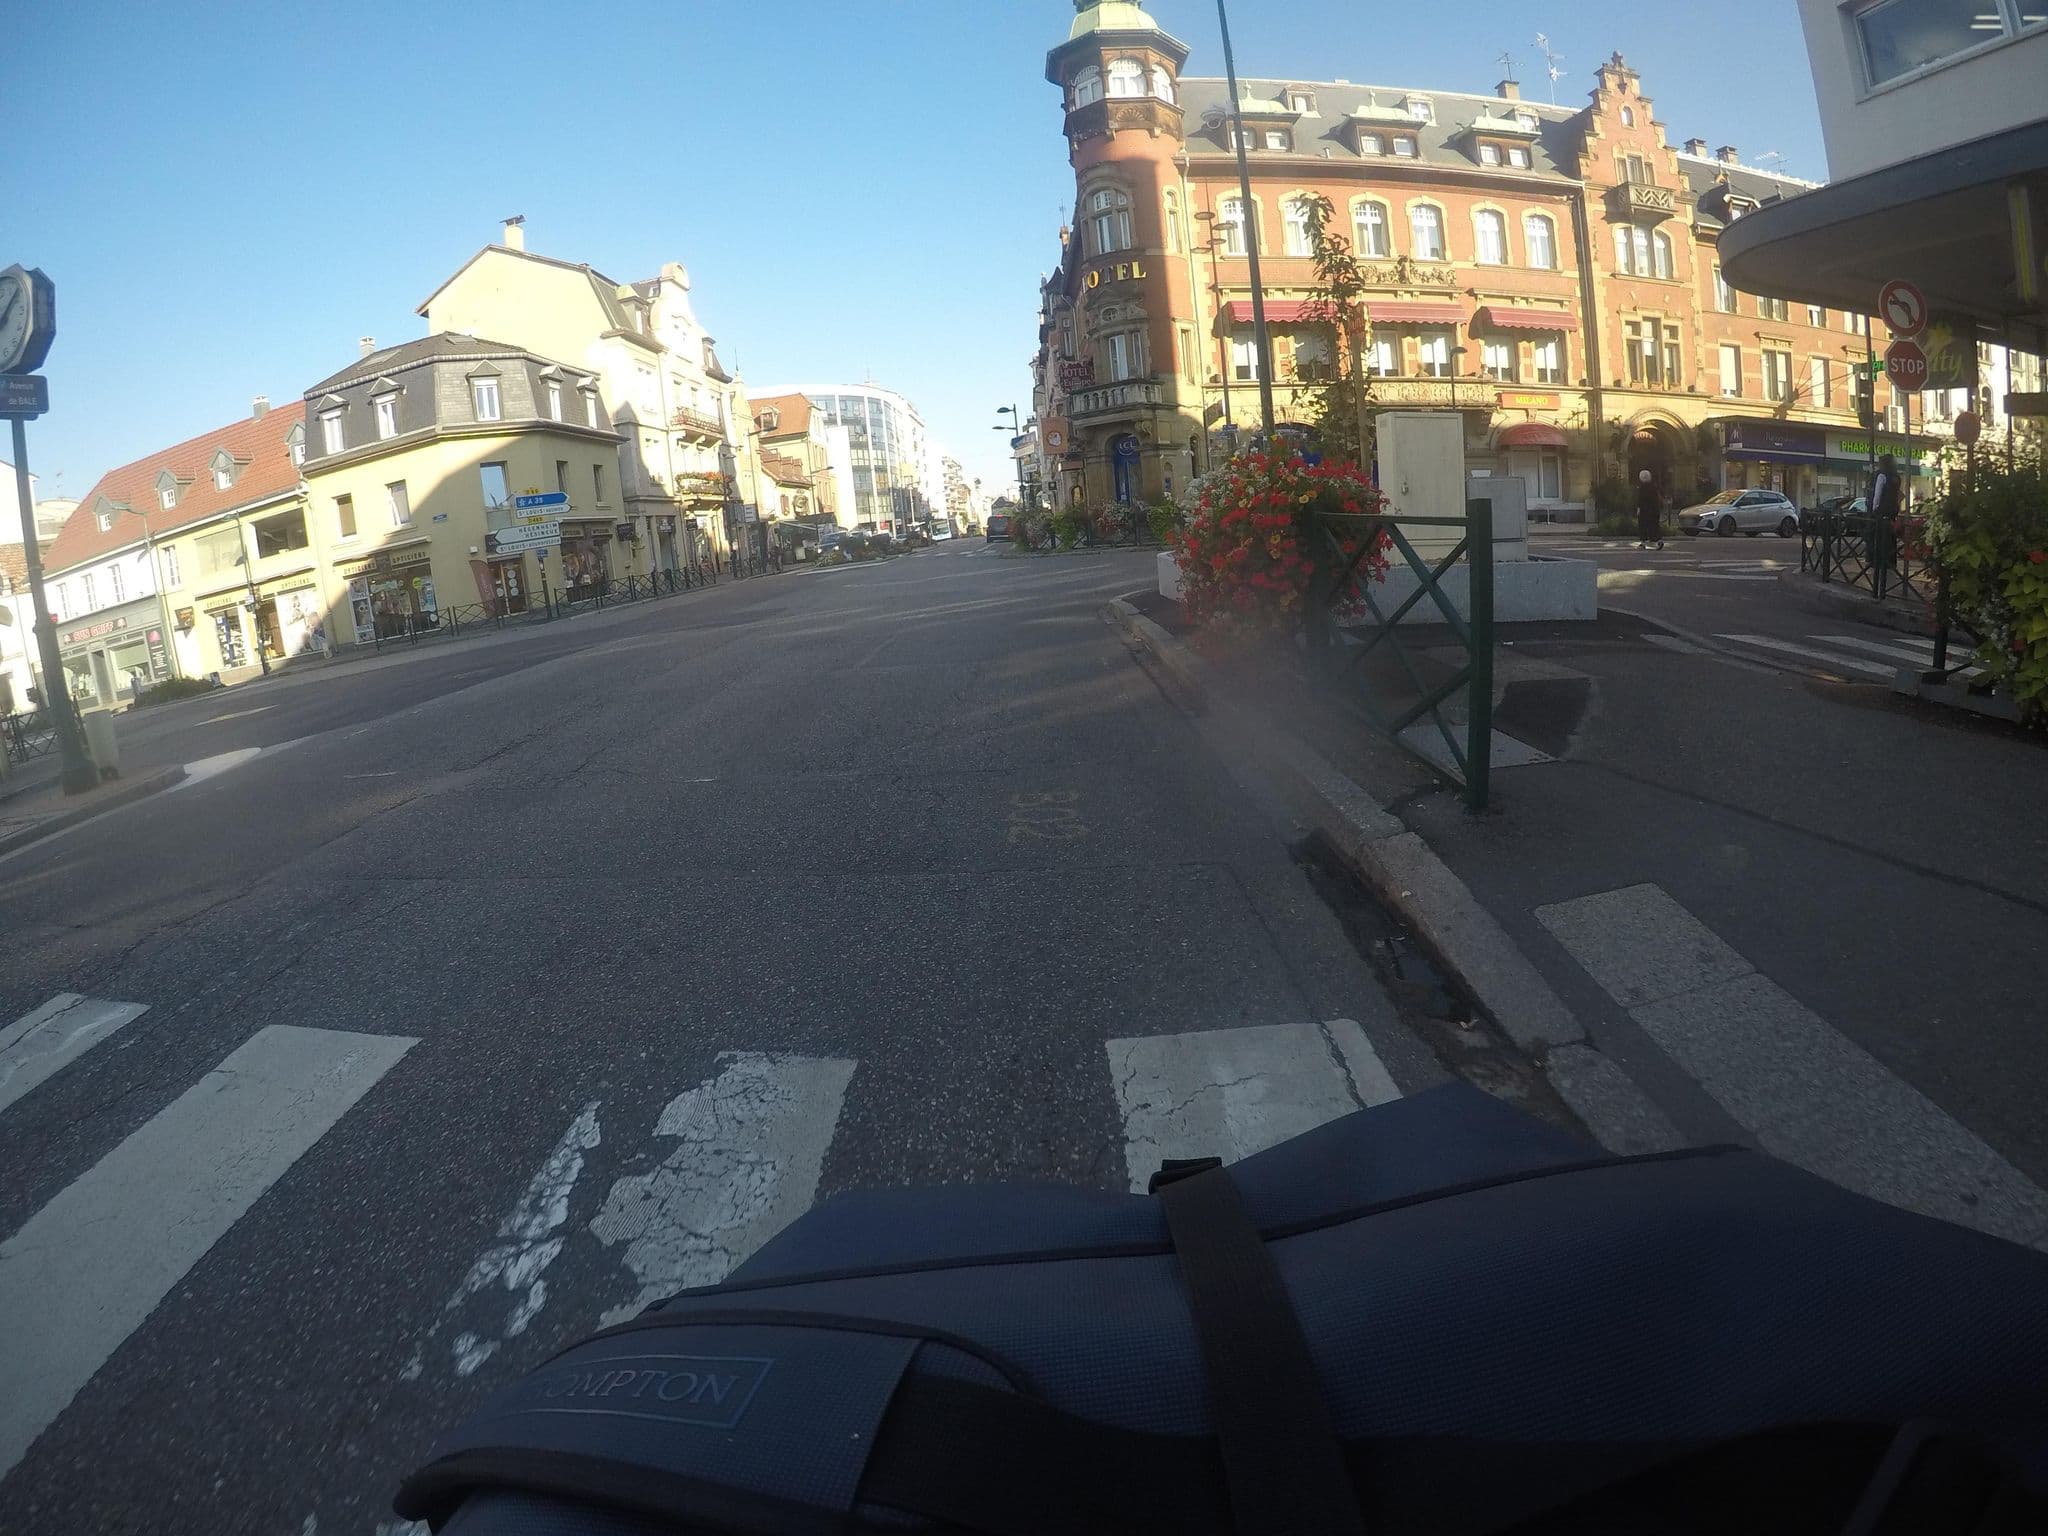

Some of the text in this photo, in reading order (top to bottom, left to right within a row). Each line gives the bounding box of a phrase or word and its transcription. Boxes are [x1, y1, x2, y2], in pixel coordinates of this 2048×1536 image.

[1890, 357, 1925, 374] STOP
[1840, 440, 1930, 460] PHARMCIE CENRAL
[532, 1369, 741, 1405] OMPTON
